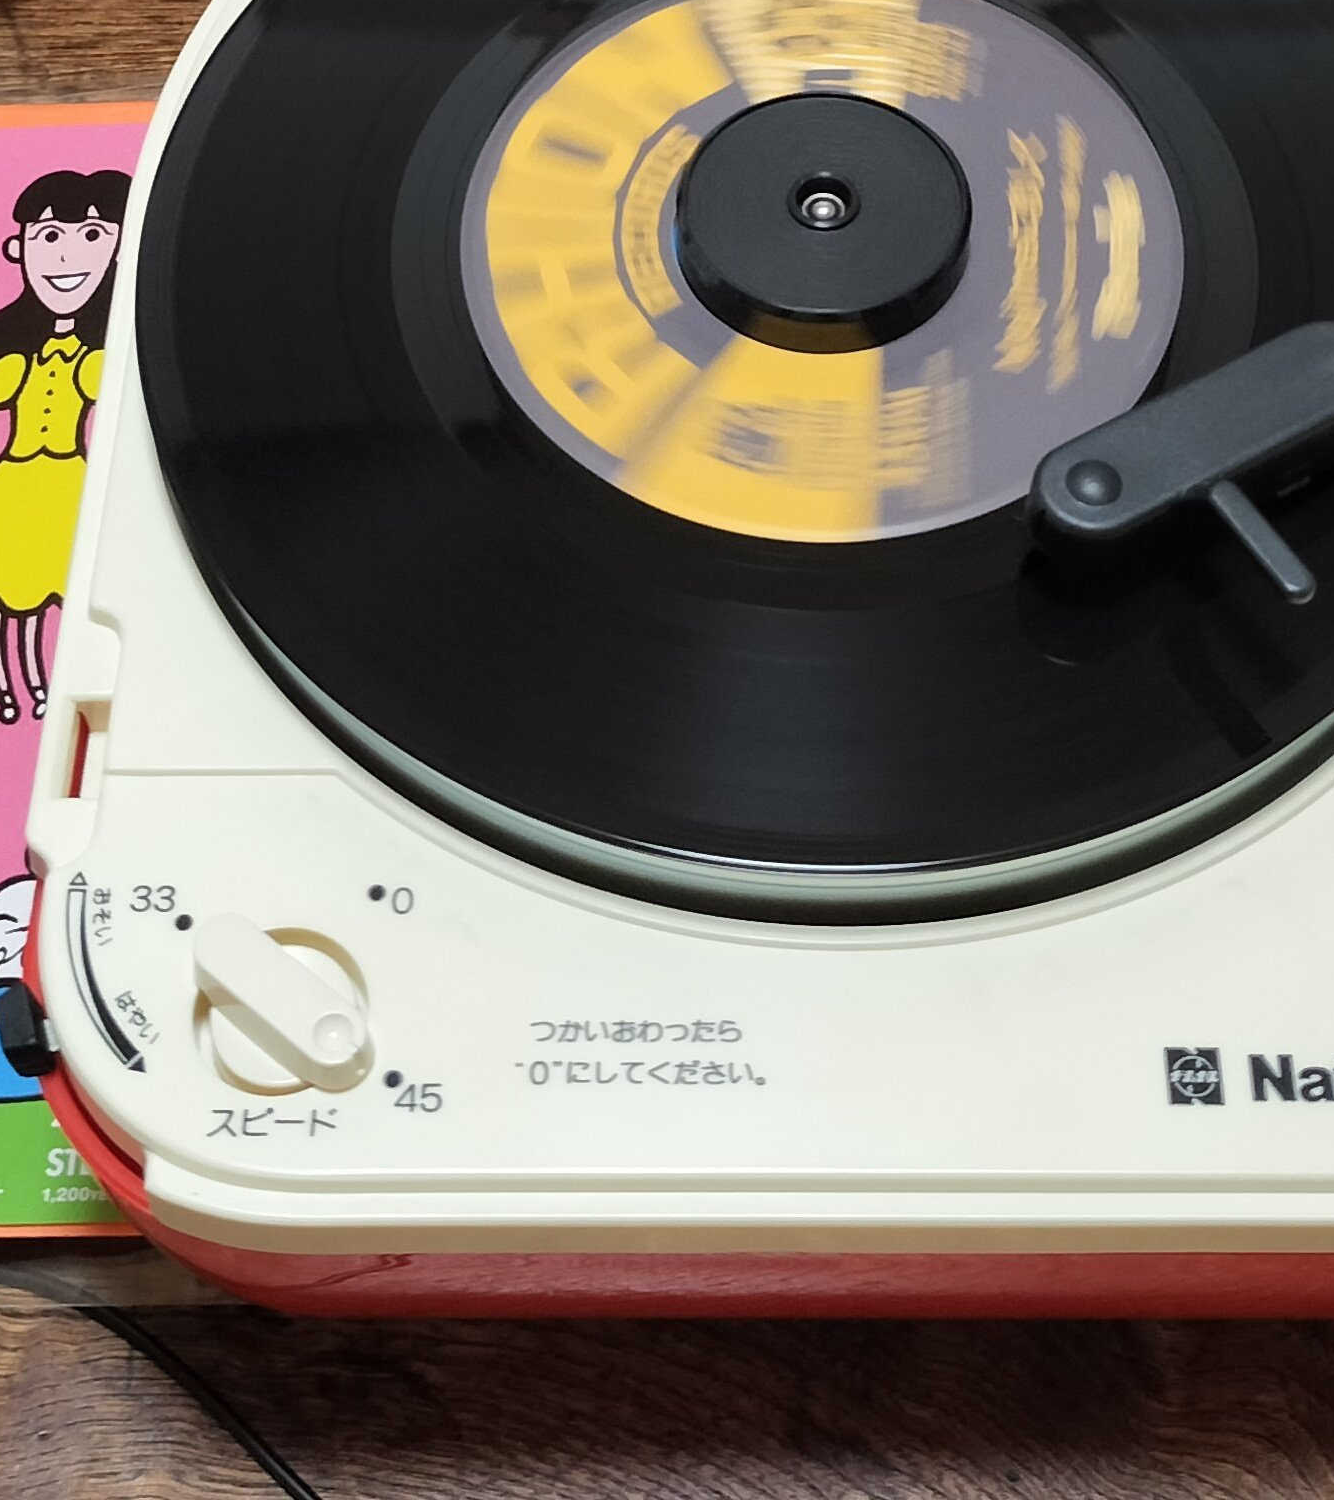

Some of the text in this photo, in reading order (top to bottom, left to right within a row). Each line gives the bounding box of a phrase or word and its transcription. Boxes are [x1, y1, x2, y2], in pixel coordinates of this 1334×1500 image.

[129, 884, 176, 913] 33
[391, 887, 414, 914] 0
[92, 888, 113, 947] おそい
[114, 990, 161, 1045] はやい
[530, 1019, 743, 1043] つかいおわったら
[394, 1083, 443, 1113] 45
[206, 1109, 338, 1138] スピード
